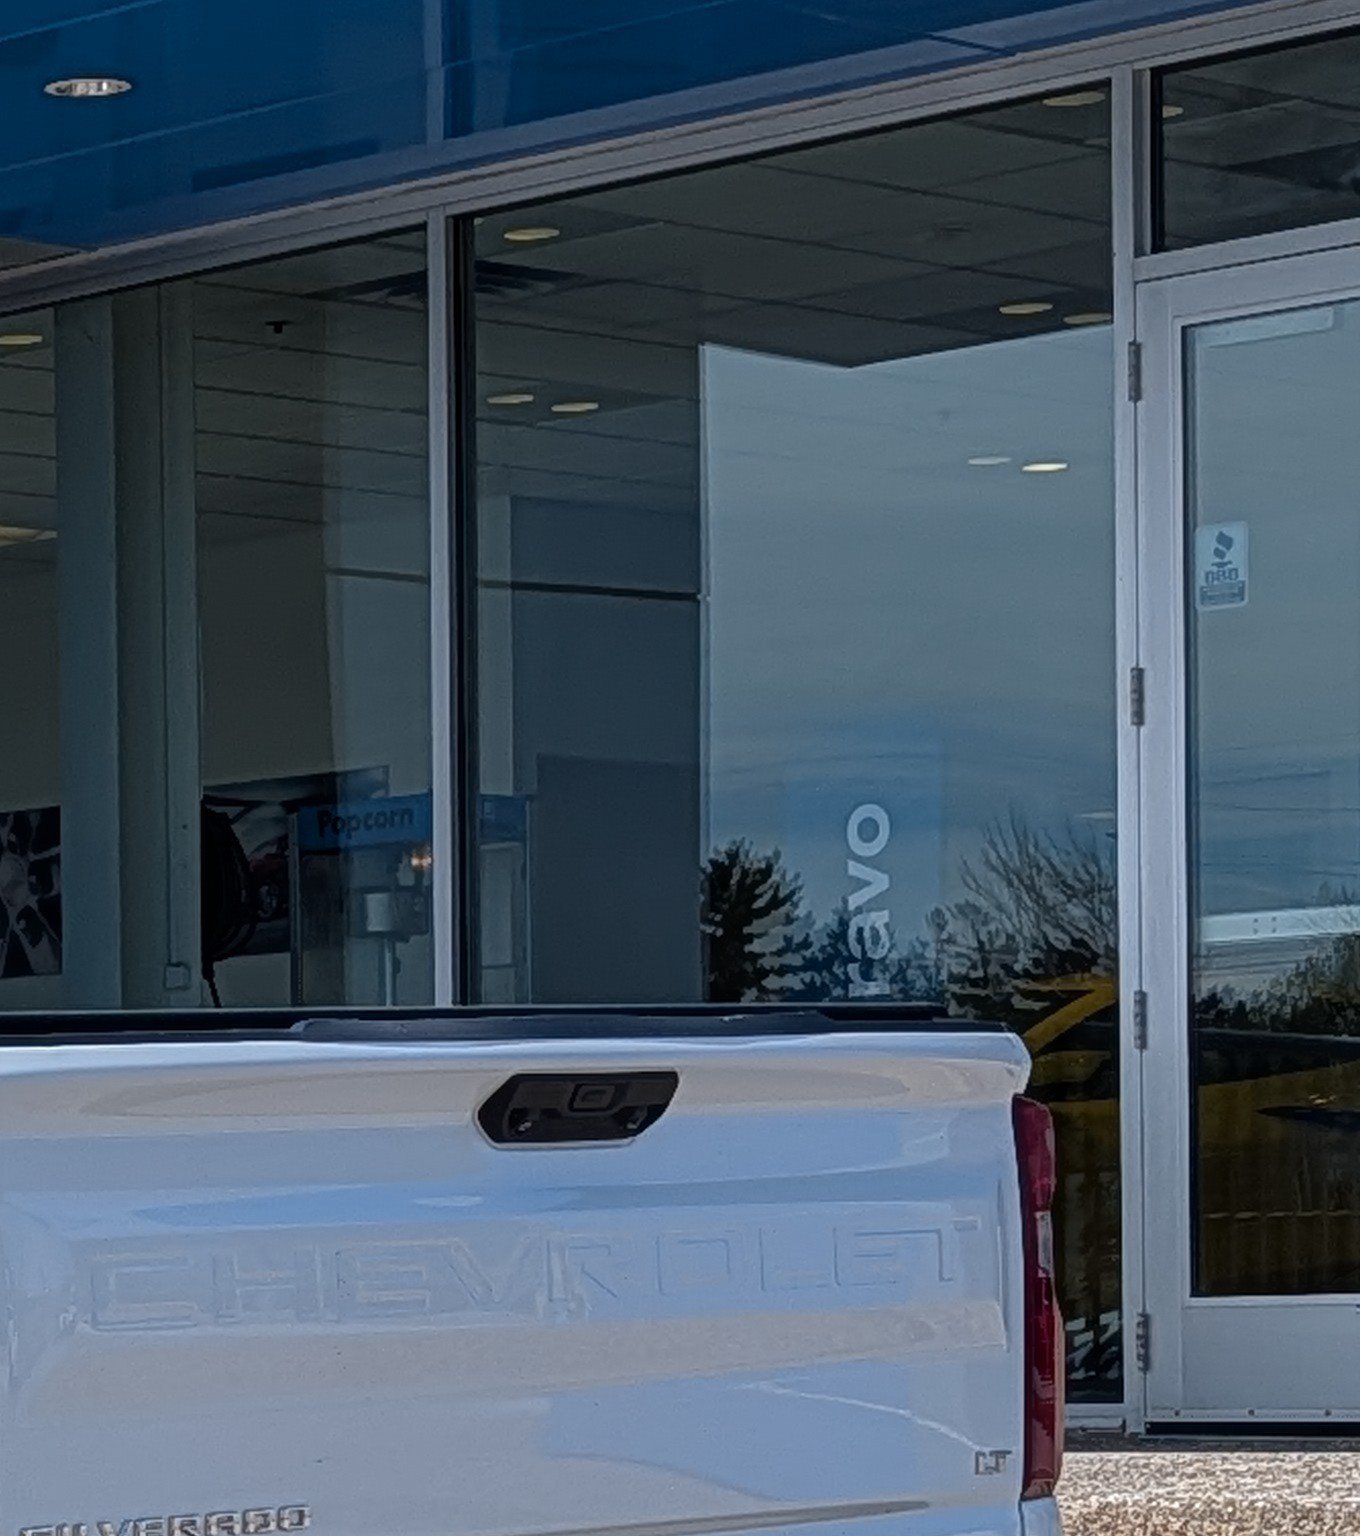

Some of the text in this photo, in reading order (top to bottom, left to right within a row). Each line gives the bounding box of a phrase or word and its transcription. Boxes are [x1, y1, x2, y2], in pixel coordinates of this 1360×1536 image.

[317, 808, 415, 840] Popcorn
[91, 1217, 981, 1331] CHEVROLET
[974, 1450, 1012, 1476] LT
